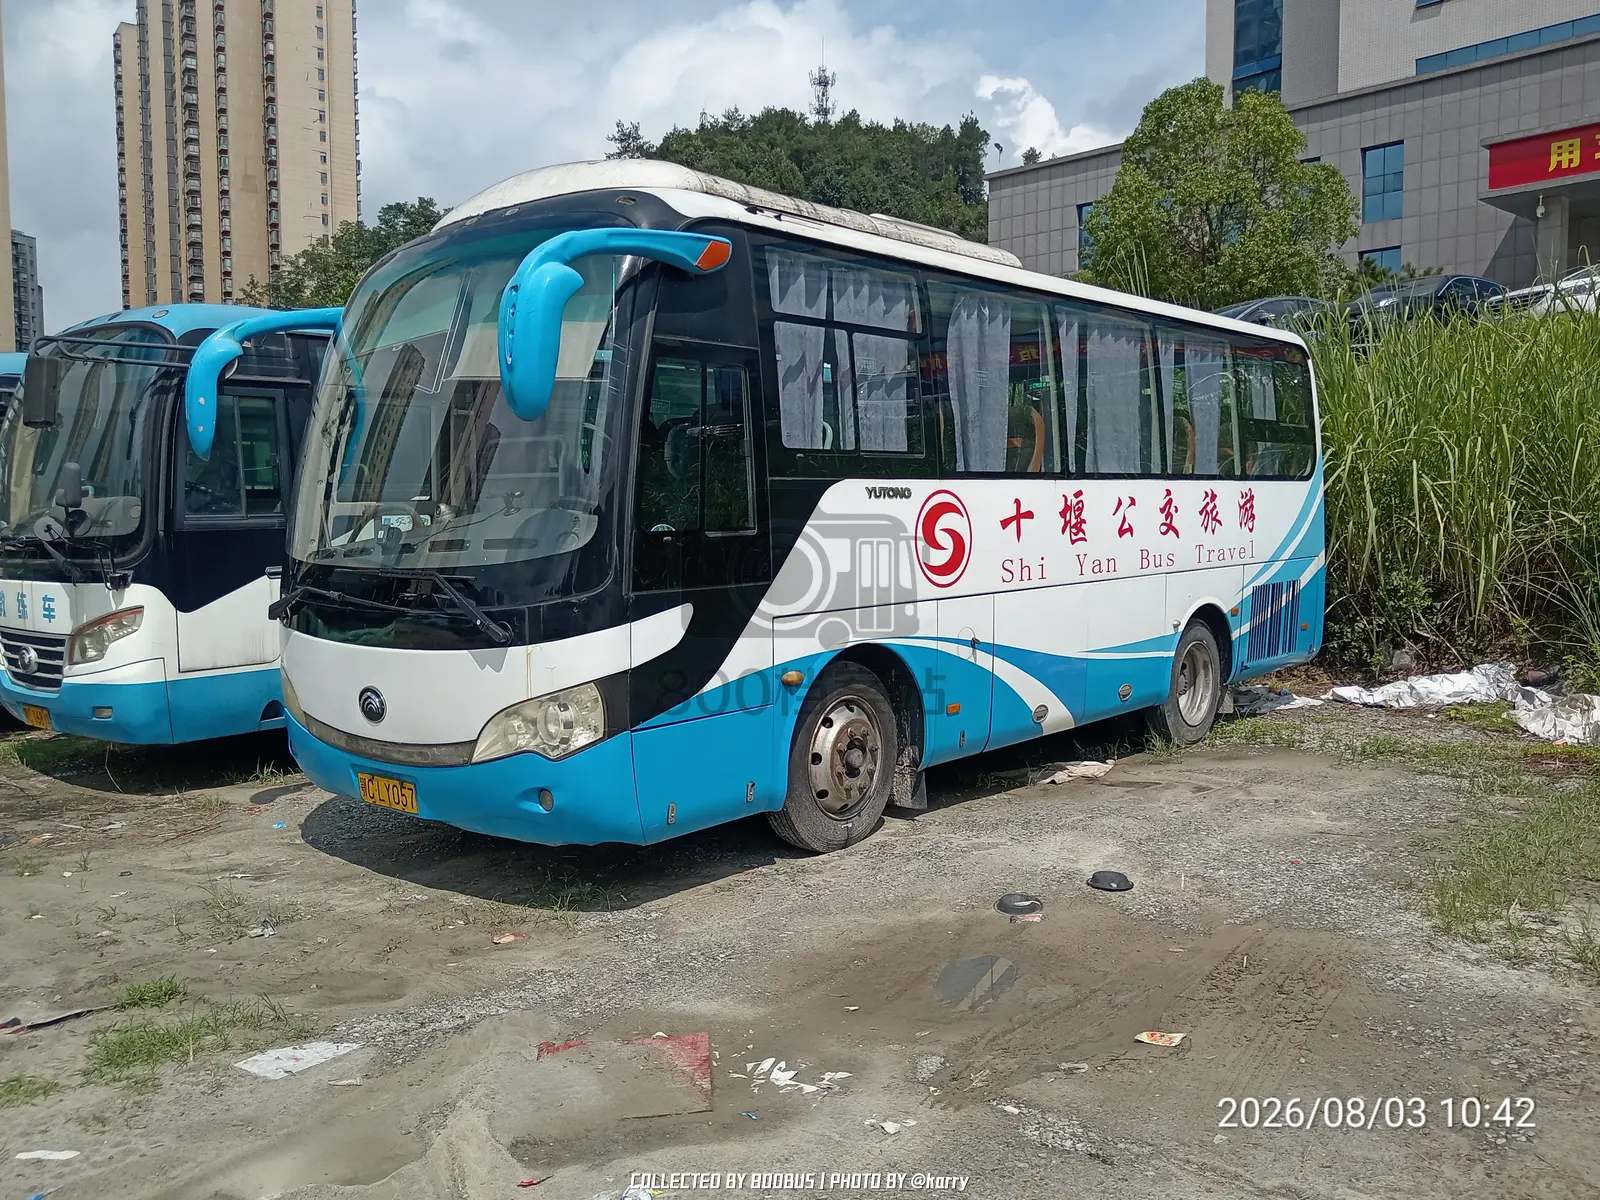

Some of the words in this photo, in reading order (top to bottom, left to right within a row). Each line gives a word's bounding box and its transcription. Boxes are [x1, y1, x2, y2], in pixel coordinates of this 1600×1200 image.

[1548, 134, 1600, 172] 用
[865, 486, 912, 499] YUTONG
[1000, 488, 1256, 545] 十堰公交旅游
[1001, 556, 1047, 583] Shi
[1076, 554, 1117, 576] Yan
[1139, 548, 1175, 570] Bus
[1195, 540, 1256, 564] Travel
